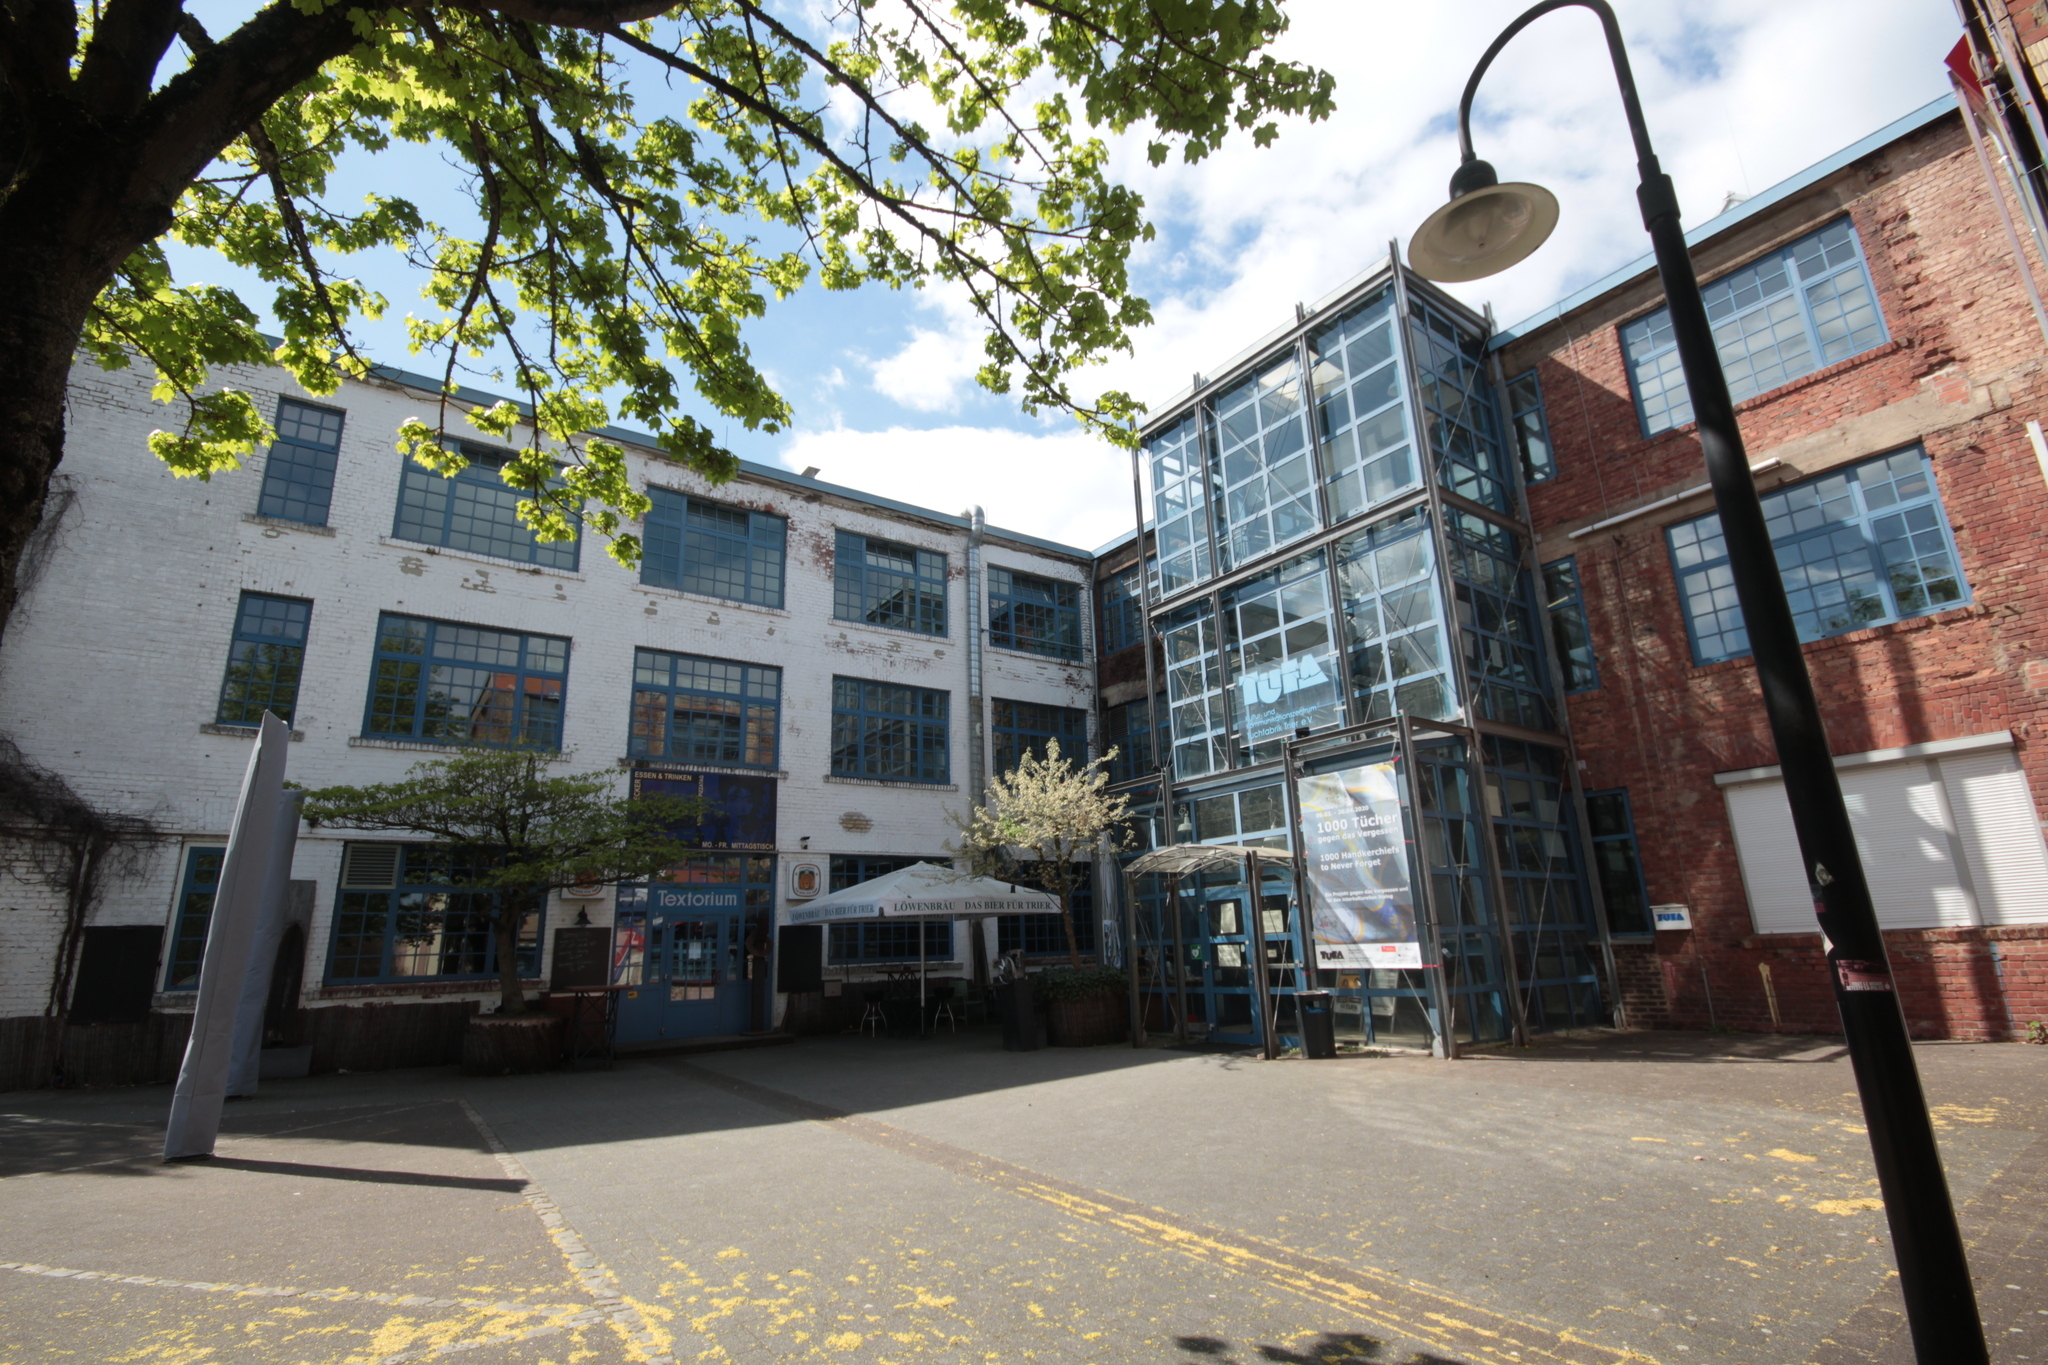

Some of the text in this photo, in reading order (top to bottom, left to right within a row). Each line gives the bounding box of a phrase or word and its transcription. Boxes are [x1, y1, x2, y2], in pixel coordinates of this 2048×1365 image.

[1239, 654, 1329, 706] TUFA
[1246, 705, 1317, 729] Kommunikationszentrum
[1263, 709, 1275, 717] und
[1247, 716, 1313, 740] Tuchfabrik Trier e.V.
[634, 771, 657, 780] ESSEN
[664, 773, 692, 781] TRINKEN
[633, 779, 642, 804] ECKER
[1317, 813, 1398, 834] 1000 Tücher
[1317, 827, 1399, 844] gegen das Vergessen
[731, 842, 774, 850] MITTAGSTISCH
[1320, 846, 1400, 862] 1000 Handkerchiefs
[1320, 858, 1381, 871] to Never Forget
[658, 890, 737, 906] Textorium
[894, 900, 1053, 912] LÖWENBRÄU DAS BIER FÜR TRIER.
[791, 904, 875, 921] LÖWENBRÄU DAS BIER FÜR TRIER.
[1656, 913, 1684, 922] TUFA
[1320, 951, 1345, 961] TUFA
